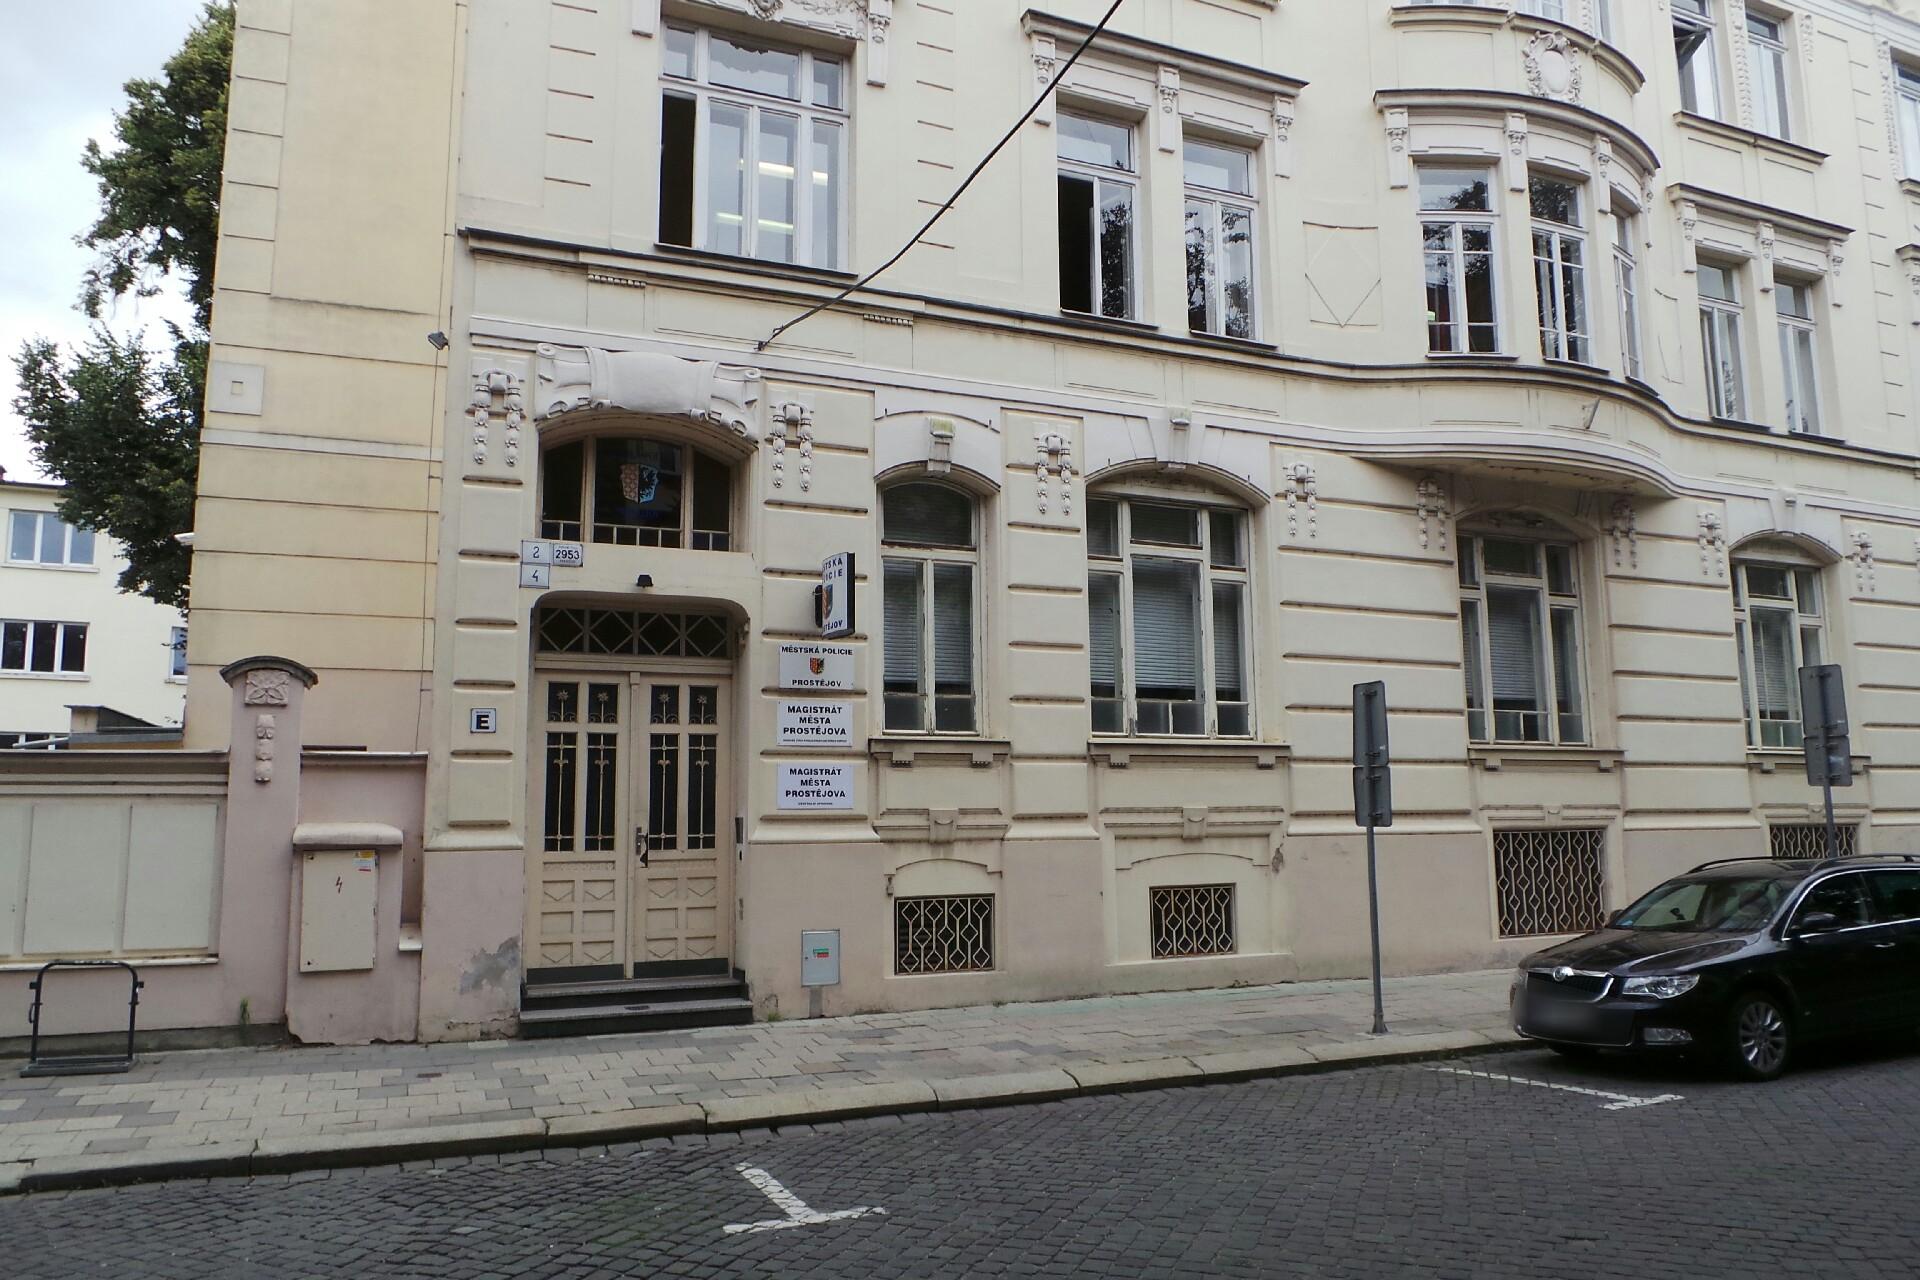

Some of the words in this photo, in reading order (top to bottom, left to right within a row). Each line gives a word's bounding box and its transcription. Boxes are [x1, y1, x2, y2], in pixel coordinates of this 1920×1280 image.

[533, 546, 540, 558] 2
[555, 550, 580, 560] 2953
[532, 570, 539, 582] 4
[782, 645, 820, 654] MĚSTSKÁ
[822, 647, 853, 655] POLICIE
[792, 679, 842, 687] PROSTĚJOV
[788, 705, 842, 714] MAGISTRÁT
[476, 715, 489, 729] E
[799, 715, 831, 724] MĚSTA
[783, 726, 846, 735] PROSTĚJOVA
[790, 767, 842, 775] MAGISTRÁT
[801, 778, 831, 787] MĚSTA
[786, 789, 846, 798] PROSTĚJOVA
